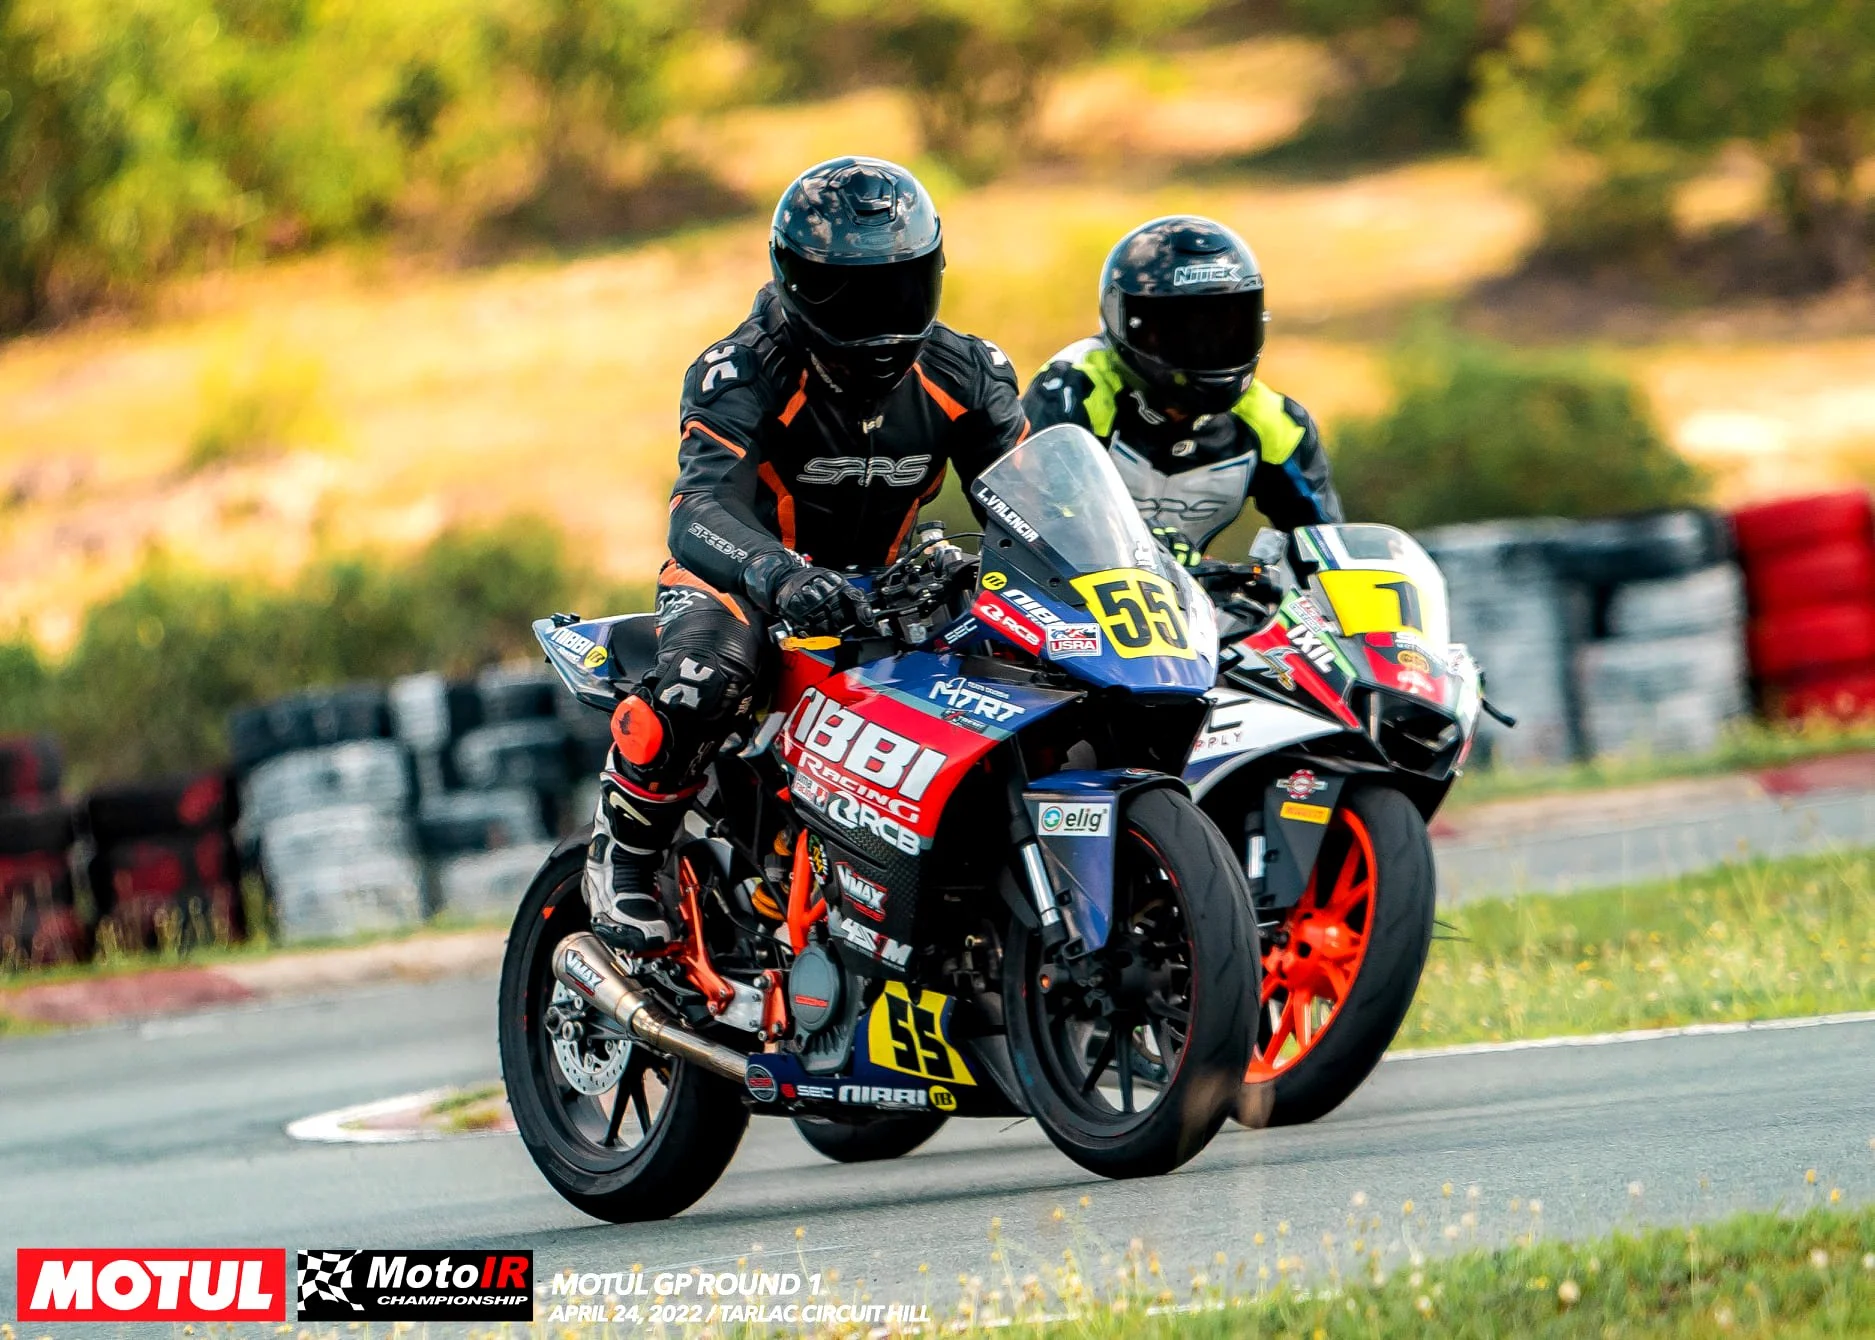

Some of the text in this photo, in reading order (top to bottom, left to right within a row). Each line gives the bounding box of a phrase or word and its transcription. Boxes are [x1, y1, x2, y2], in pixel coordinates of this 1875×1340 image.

[1092, 580, 1188, 650] 55
[1374, 580, 1423, 633] 1
[1051, 640, 1096, 652] USRA
[1193, 732, 1242, 751] PPLY
[799, 752, 922, 824] RACING
[885, 992, 955, 1080] 55
